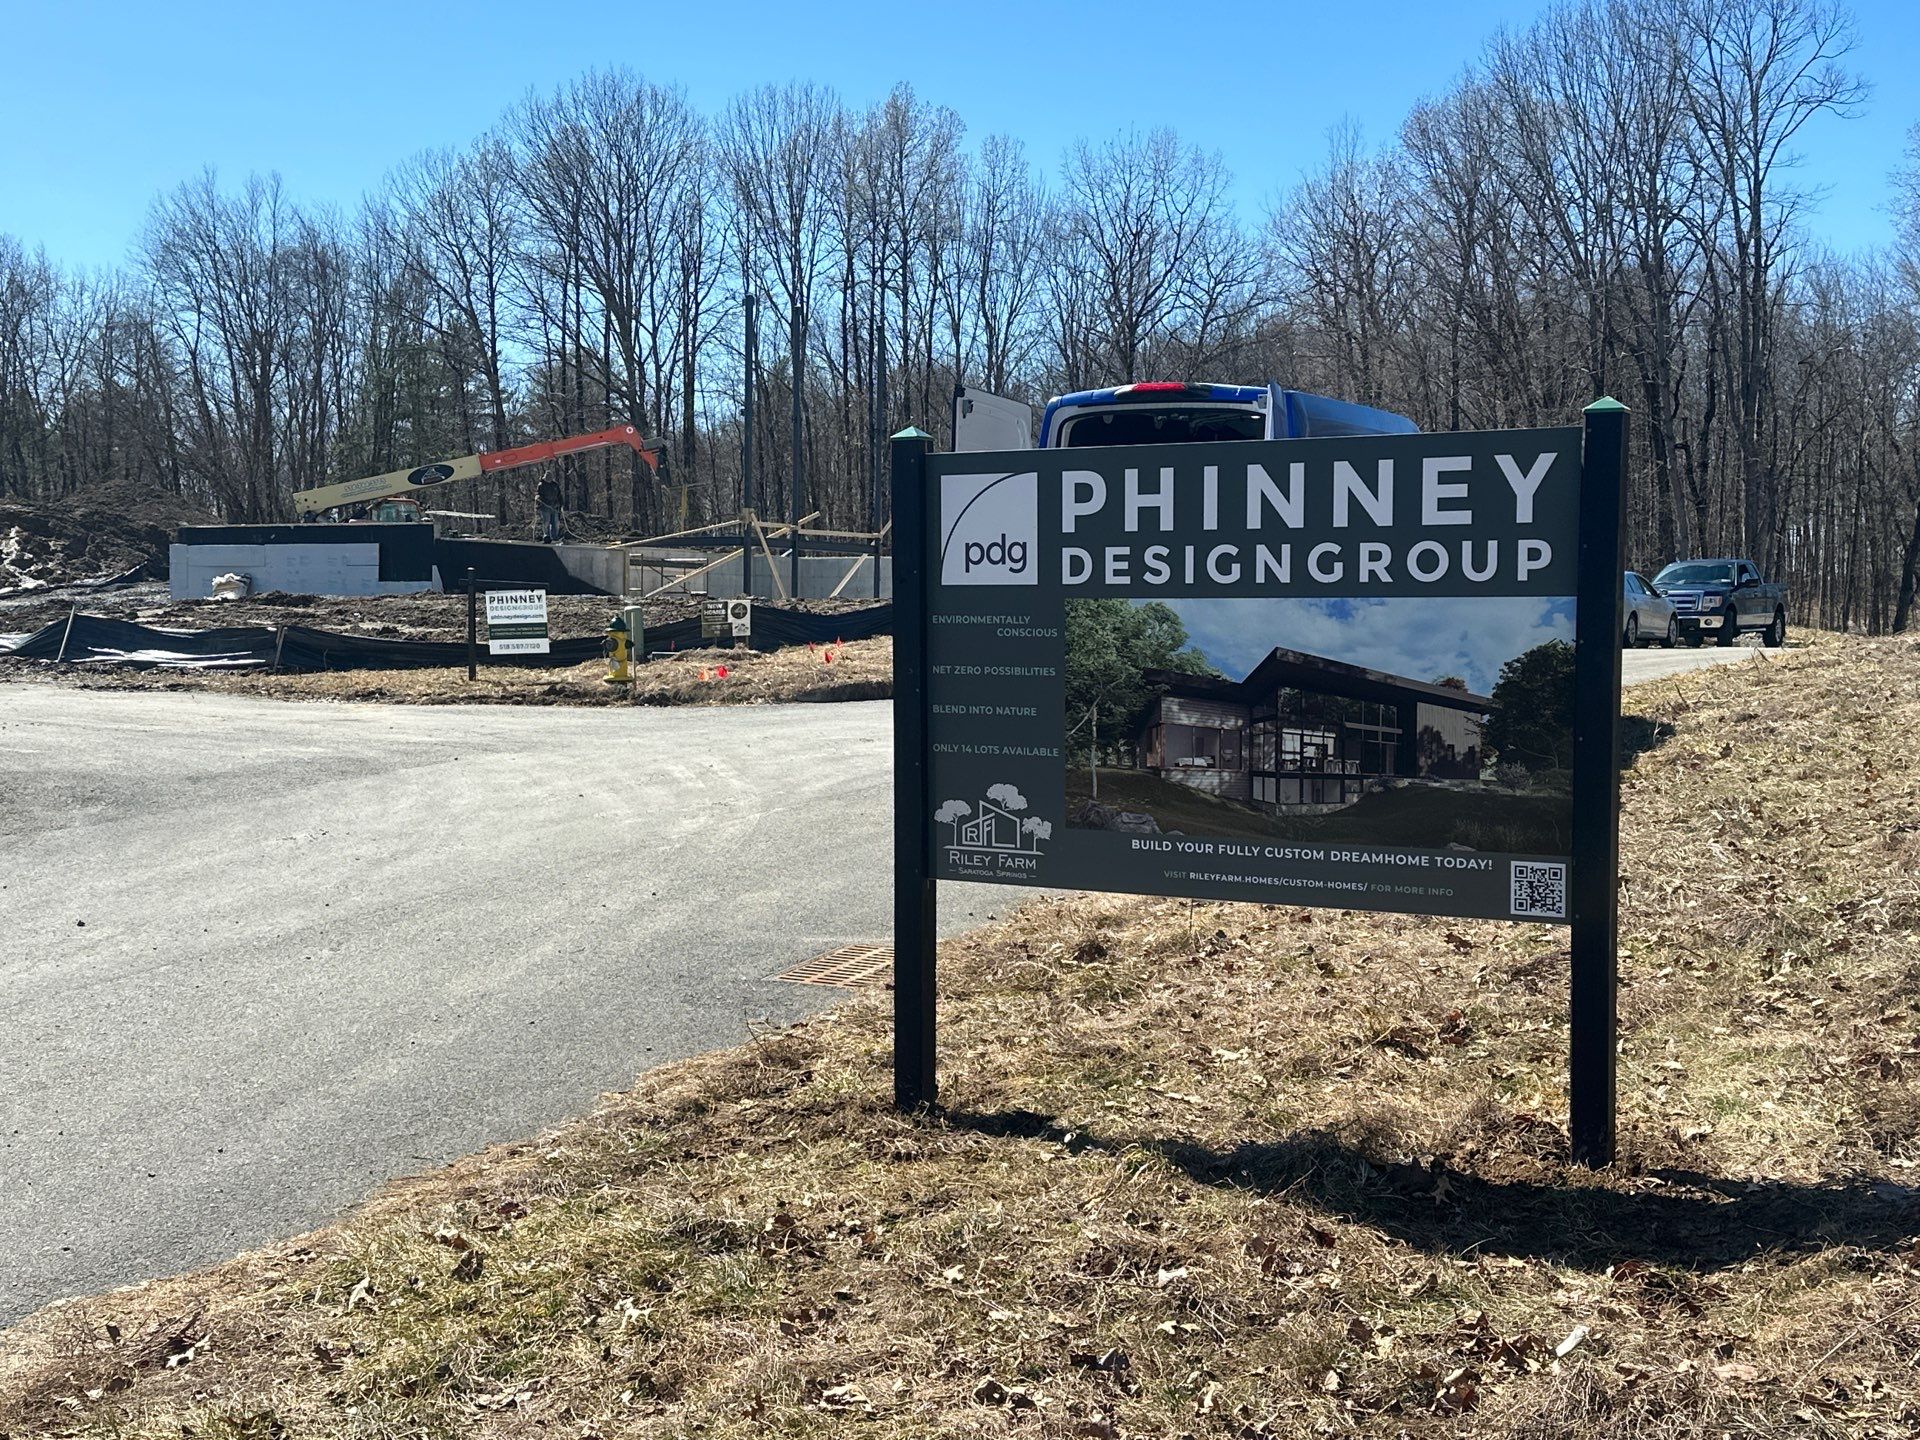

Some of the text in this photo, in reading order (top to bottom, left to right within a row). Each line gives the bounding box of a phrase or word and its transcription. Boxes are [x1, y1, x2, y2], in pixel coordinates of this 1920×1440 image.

[1061, 451, 1557, 533] PHINNEY
[964, 533, 1027, 572] pdg
[1061, 539, 1553, 585] DESIGNGROUP
[489, 594, 543, 604] PHINNEY
[734, 604, 746, 618] 4
[932, 615, 1030, 625] ENVIRONMENTALLY
[997, 628, 1058, 637] CONSCIOUS
[932, 665, 1056, 676] NET ZERO POSSIBILITIES
[932, 704, 1037, 716] BLEND INTO NATURE
[932, 743, 1060, 757] ONLY 14 LOTS AVAILABLE
[949, 851, 1037, 870] RILEY FARM
[1131, 839, 1493, 870] BUILD YOUR FULLY CUSTOM DREAMHOME TODAY!
[958, 867, 1027, 879] SARATOGA SPRINGS
[1163, 870, 1187, 880] VISIT
[1371, 884, 1391, 893] FOR
[1394, 885, 1425, 895] MORE
[1428, 887, 1454, 897] INFO
